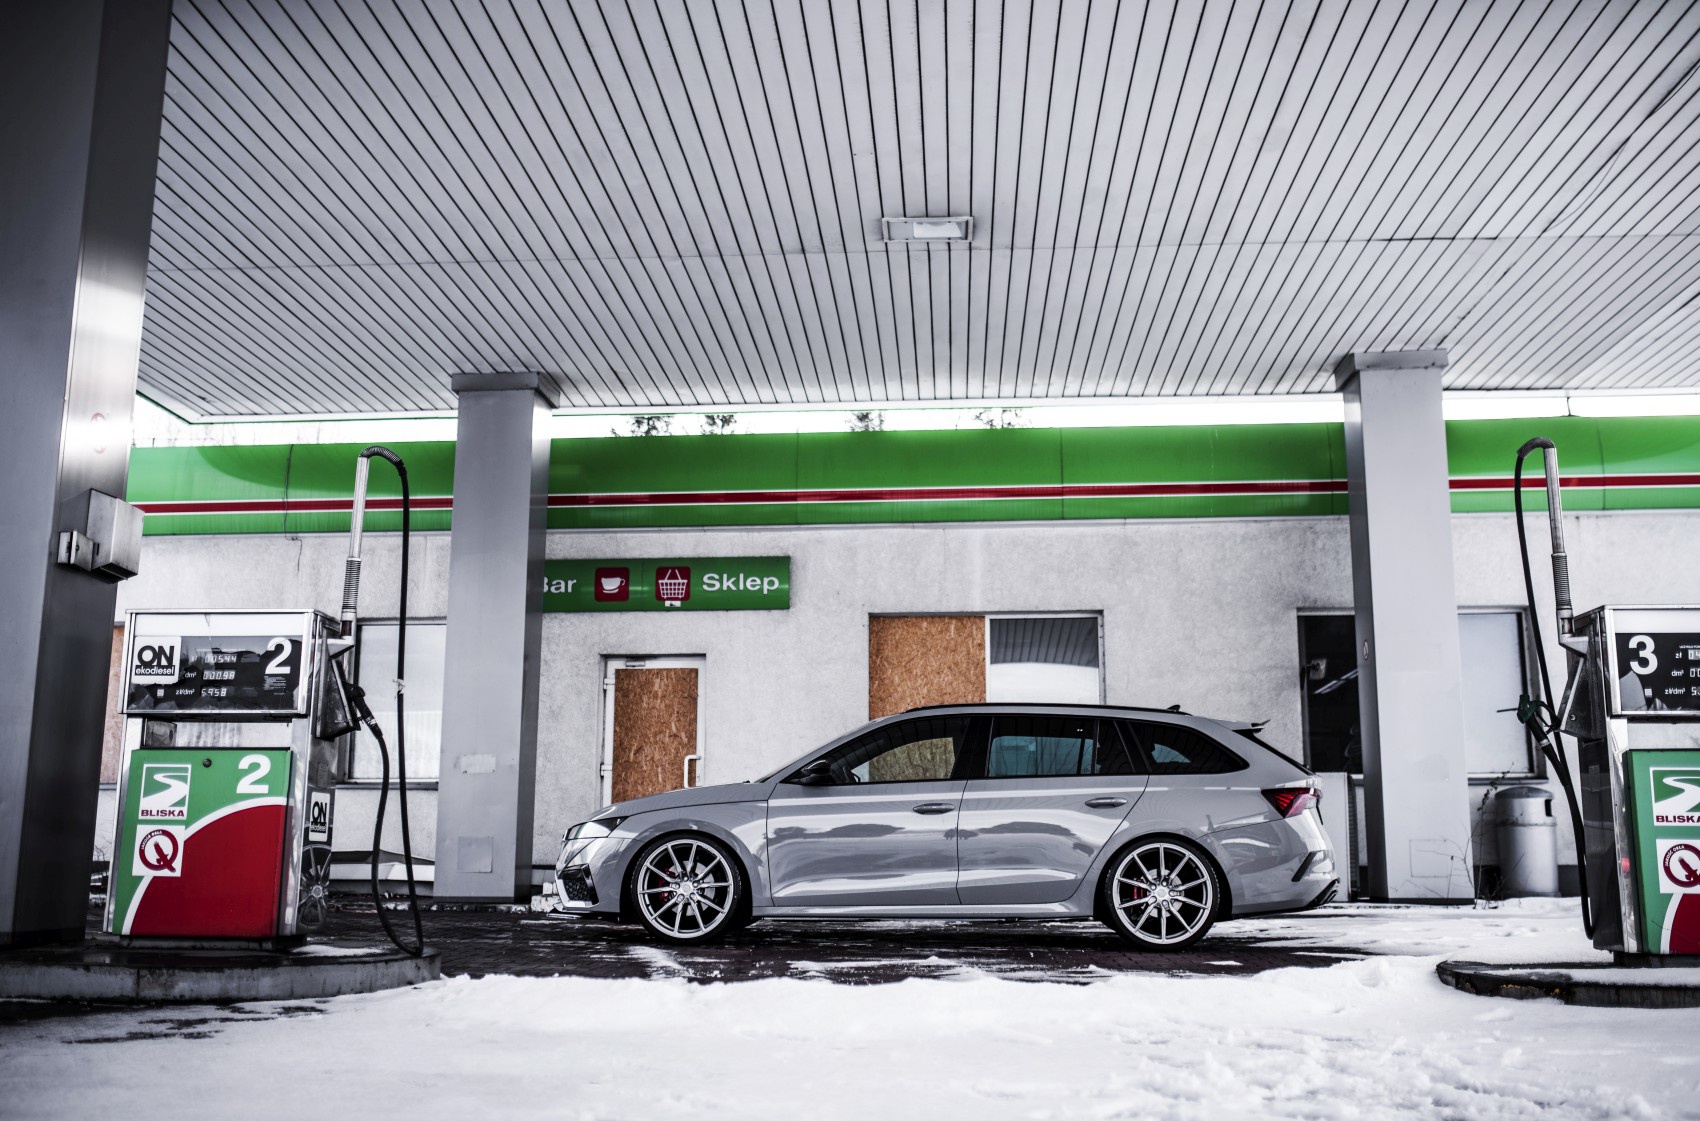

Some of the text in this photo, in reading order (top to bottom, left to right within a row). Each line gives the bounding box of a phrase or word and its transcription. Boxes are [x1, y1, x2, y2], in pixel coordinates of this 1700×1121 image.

[702, 573, 780, 595] Sklep
[137, 645, 175, 667] ON
[264, 637, 291, 675] 2
[1628, 634, 1658, 675] 3
[135, 665, 175, 675] ekodiesel
[236, 754, 271, 794] 2
[140, 808, 185, 818] BLISKA
[312, 800, 328, 823] ON
